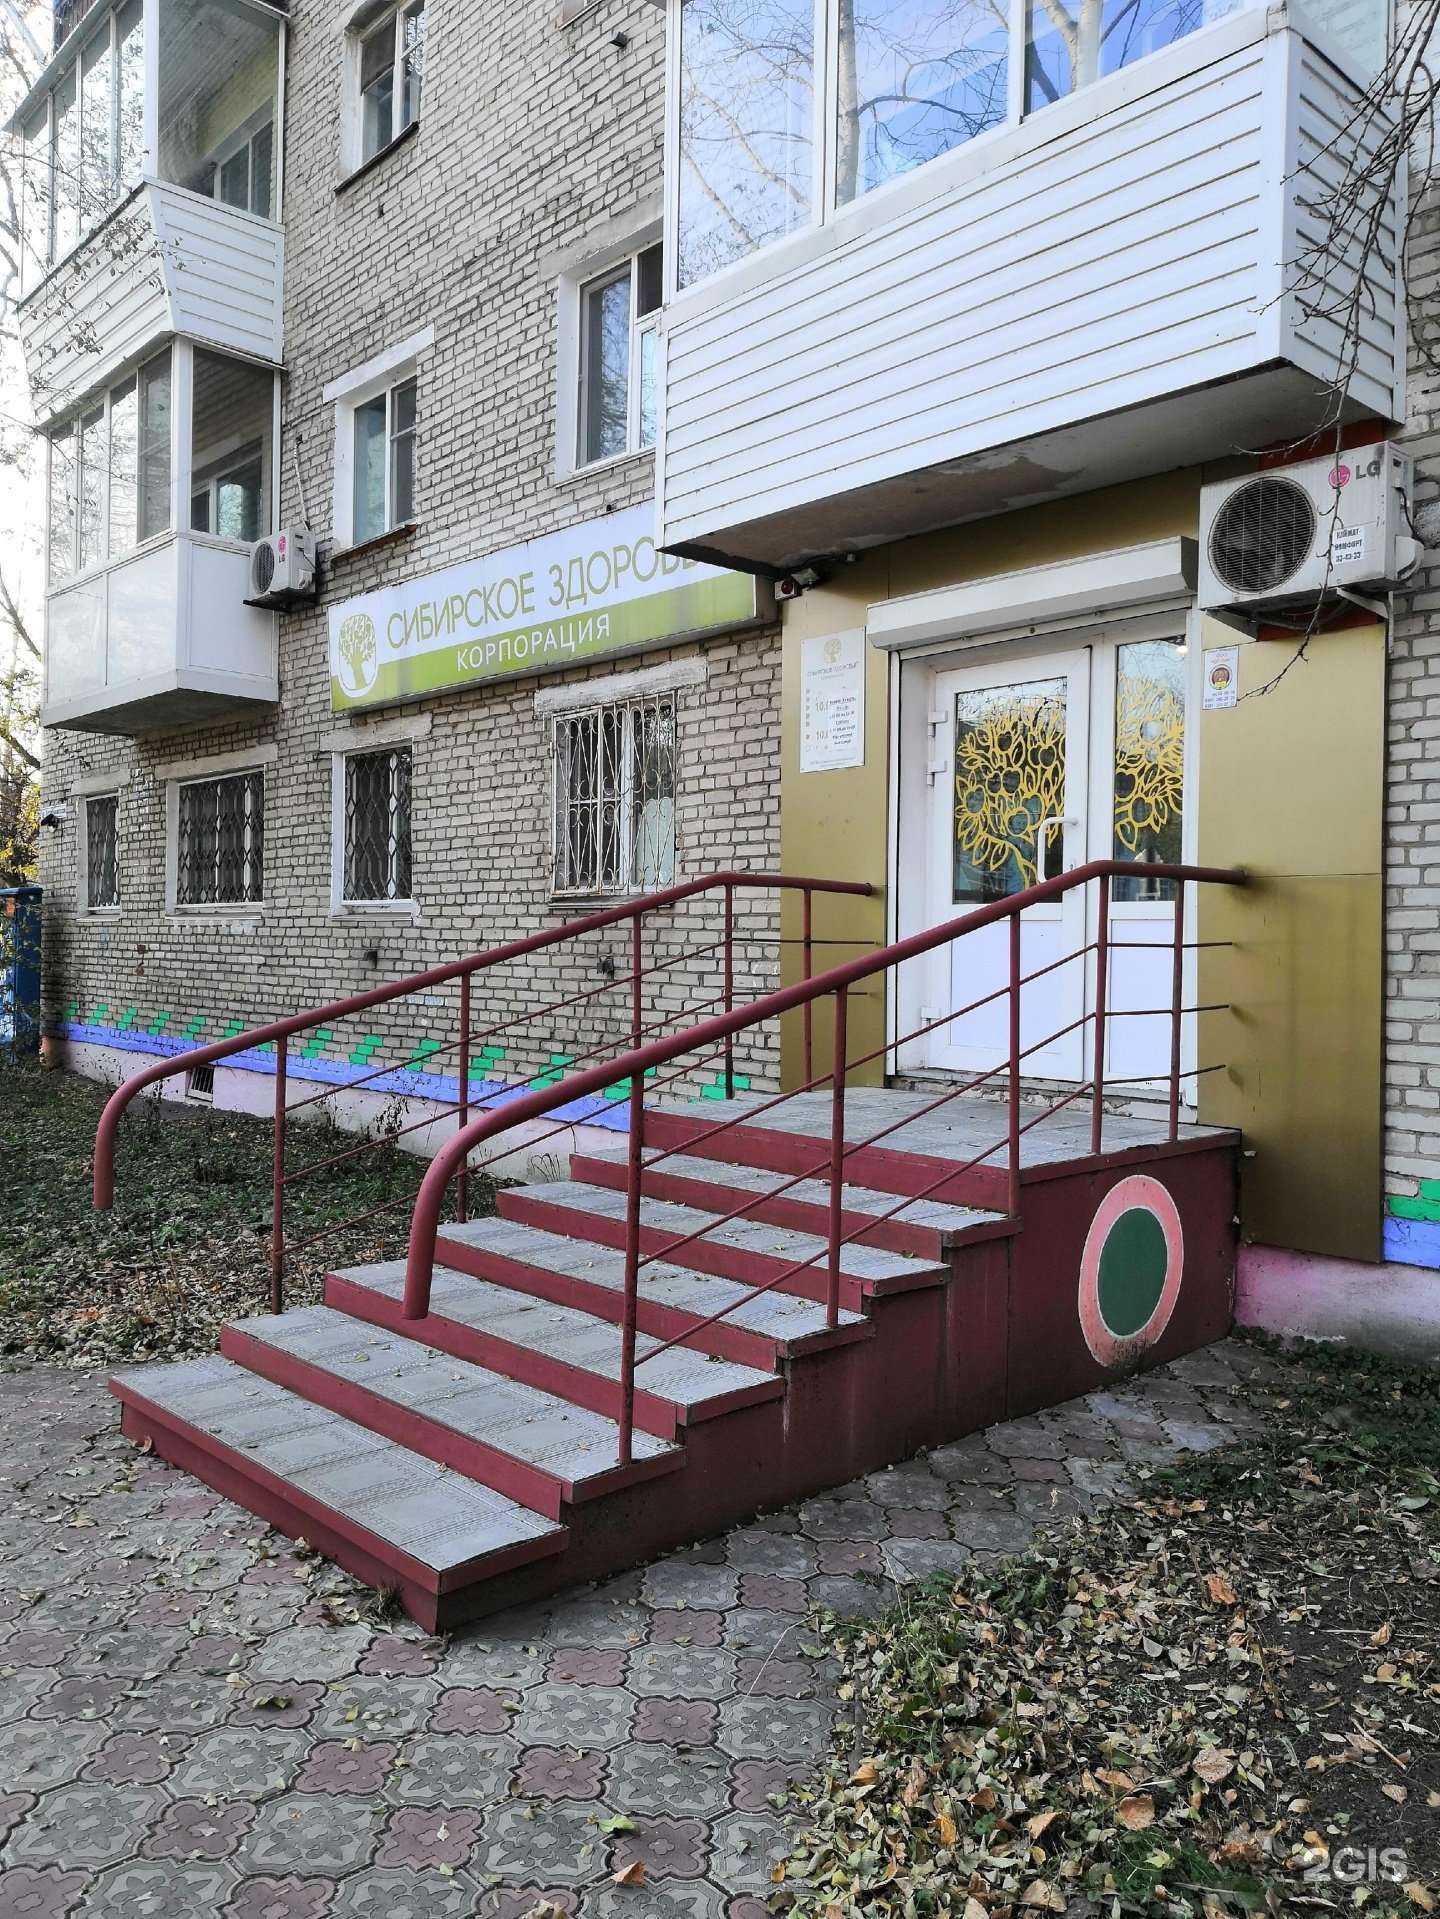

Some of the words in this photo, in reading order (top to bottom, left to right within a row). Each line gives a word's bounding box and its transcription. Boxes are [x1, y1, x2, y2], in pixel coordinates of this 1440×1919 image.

[1355, 460, 1381, 480] LG
[386, 571, 536, 649] СИБИРСКОЕ
[457, 613, 611, 673] КОРПОРАЦИЯ
